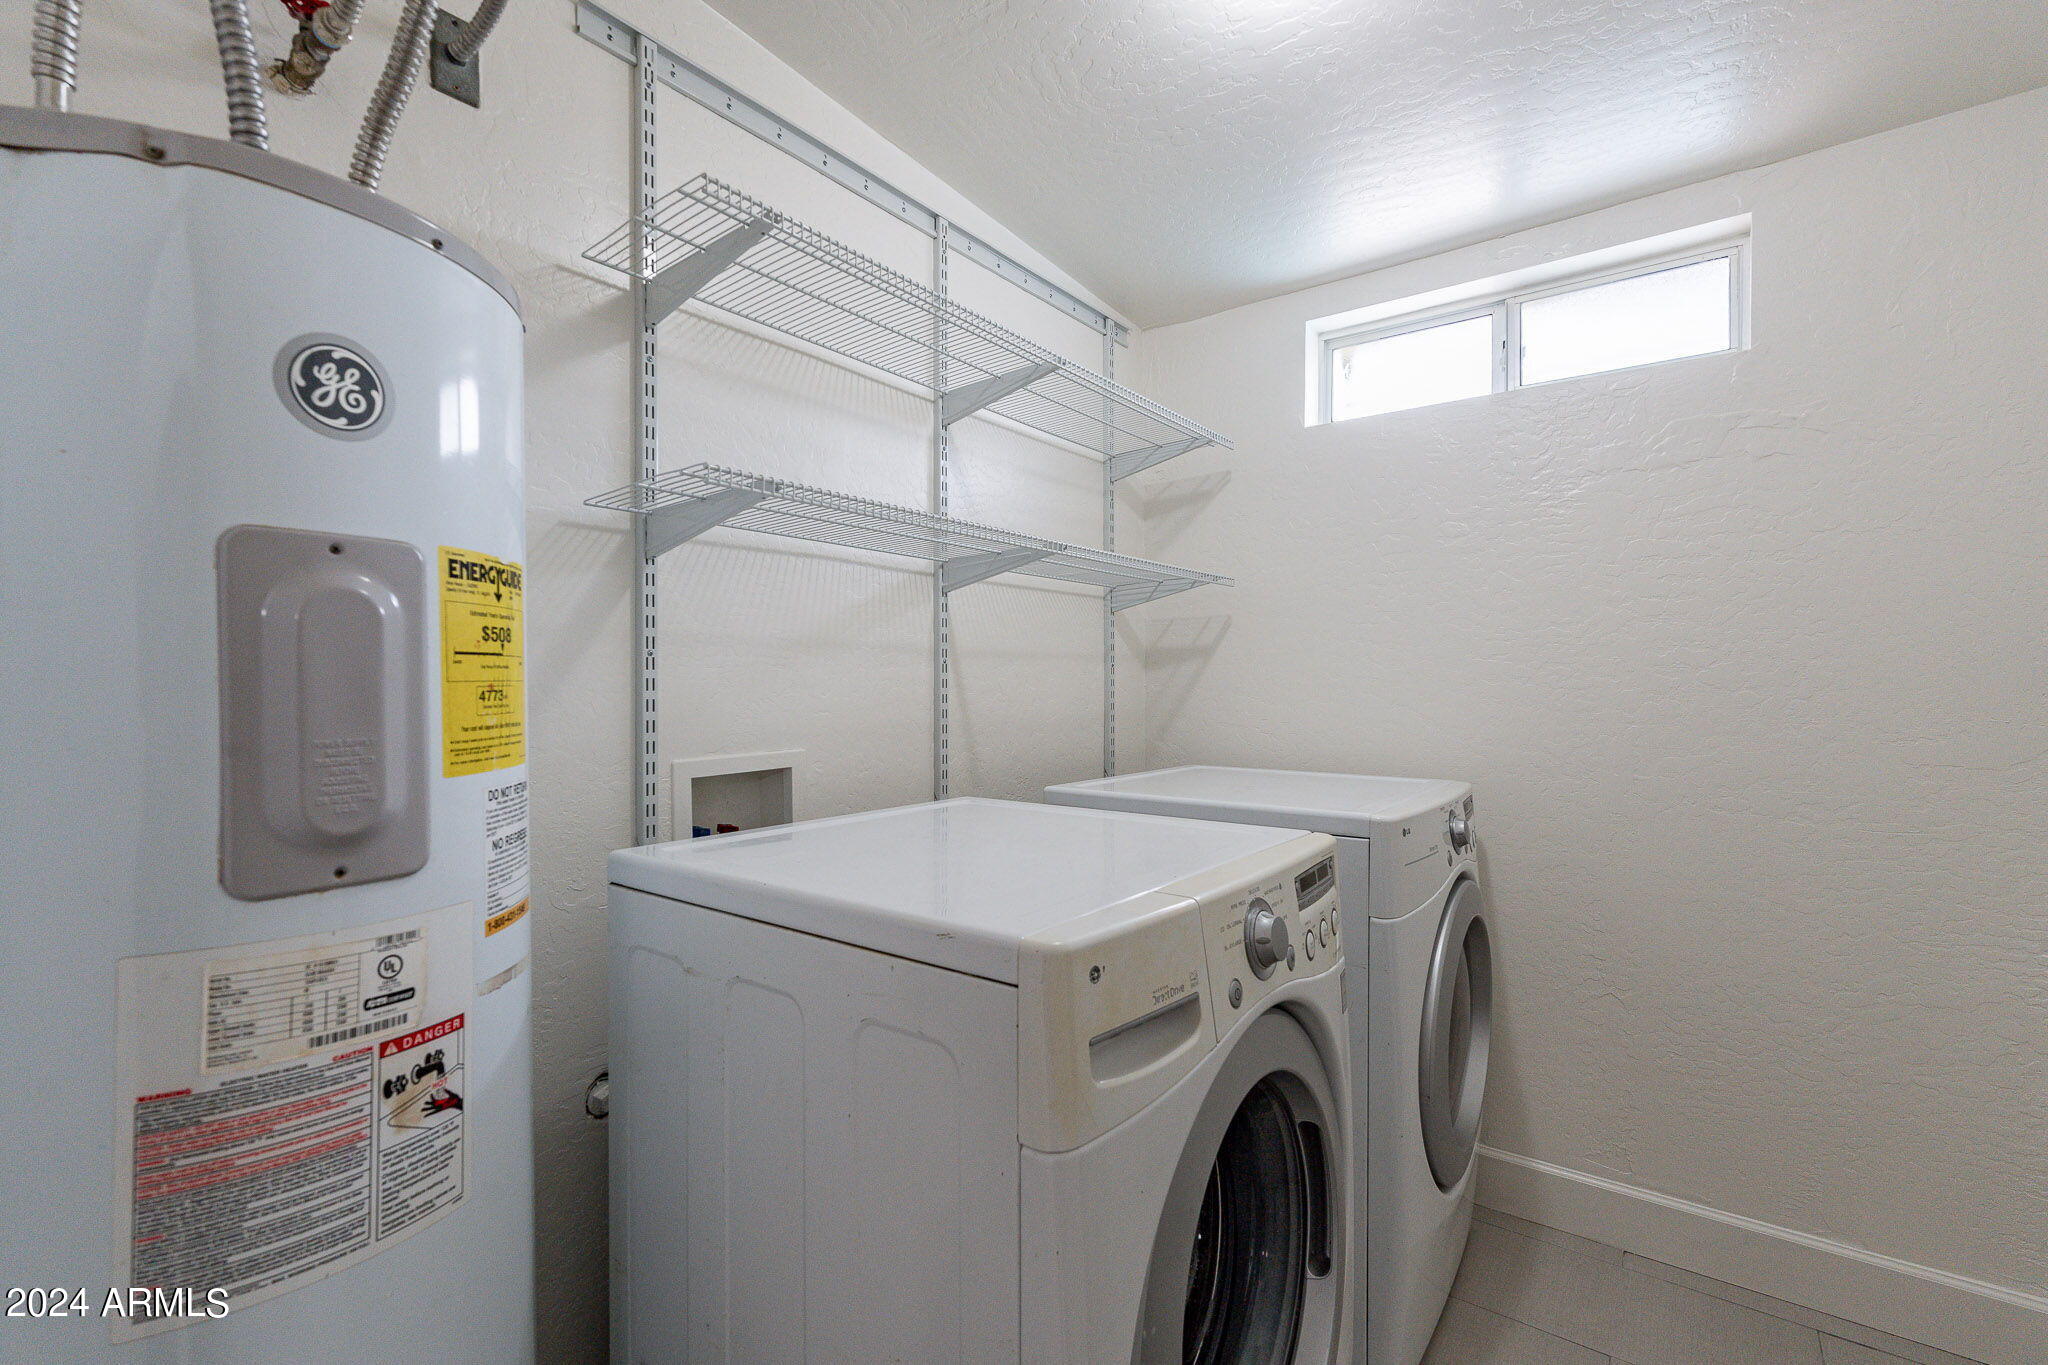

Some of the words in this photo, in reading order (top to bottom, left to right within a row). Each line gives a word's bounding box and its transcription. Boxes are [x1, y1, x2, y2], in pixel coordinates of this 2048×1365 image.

[448, 558, 522, 592] ENERGYGUIDE
[482, 625, 512, 643] $508
[479, 689, 504, 702] 4773
[488, 789, 500, 801] DO
[501, 785, 513, 798] NOT
[492, 837, 504, 851] NO
[402, 1018, 461, 1048] DANGER
[332, 1046, 374, 1062] CAUTION
[432, 1077, 448, 1090] HOT
